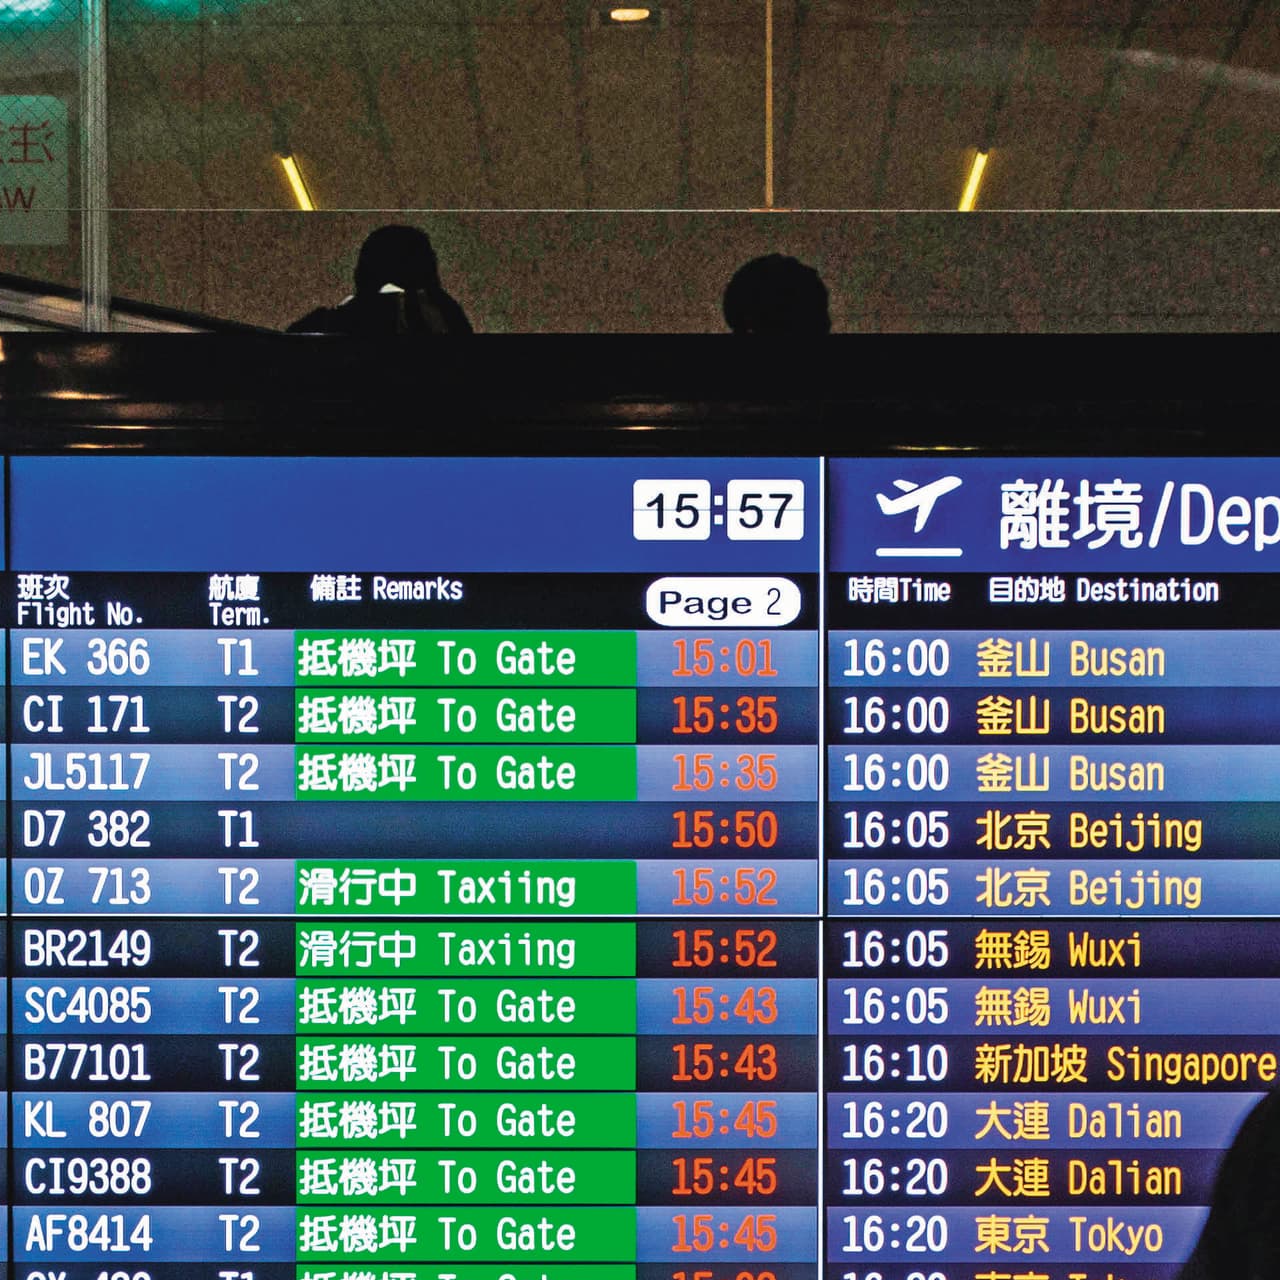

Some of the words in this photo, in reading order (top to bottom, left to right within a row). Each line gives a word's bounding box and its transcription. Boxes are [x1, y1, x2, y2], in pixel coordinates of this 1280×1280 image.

[646, 492, 793, 531] 15:57
[17, 573, 70, 601] 班次
[309, 574, 362, 602] 備註
[373, 575, 463, 600] Remarks
[660, 590, 752, 621] Page
[766, 587, 781, 616] 2
[848, 575, 951, 604] 時間Time
[989, 575, 1066, 603] 目的地
[1077, 577, 1219, 602] Destination
[17, 601, 96, 628] Flight
[107, 601, 143, 626] No.
[208, 601, 270, 626] Term.
[22, 637, 67, 675] EK
[86, 637, 151, 676] 366
[216, 637, 259, 676] T1
[298, 638, 417, 677] 抵機坪
[437, 640, 477, 675] To
[496, 640, 576, 675] Gate
[671, 637, 779, 677] 15:01
[843, 638, 950, 677] 16:00
[976, 637, 1050, 677] 釜山
[1070, 639, 1165, 677] Busan
[23, 694, 64, 733] CI
[87, 695, 150, 733] 171
[217, 695, 259, 733] T2
[298, 695, 417, 735] 抵機坪
[437, 698, 477, 733] To
[496, 698, 576, 733] Gate
[672, 696, 778, 734] 15:35
[23, 752, 151, 791] JL5117
[217, 752, 260, 791] T2
[23, 809, 66, 847] D7
[87, 809, 151, 848] 382
[217, 809, 259, 848] T1
[672, 810, 778, 848] 15:50
[24, 866, 65, 905] OZ
[87, 866, 151, 905] 713
[217, 866, 260, 905] T2
[299, 867, 416, 906] 滑行中
[437, 870, 576, 908] Taxiing
[671, 866, 778, 906] 15:52
[843, 867, 949, 906] 16:05
[975, 866, 1051, 908] 北京
[1069, 869, 1202, 909] Beijing
[975, 928, 1051, 970] 無錫
[1068, 931, 1141, 967] Wuxi
[24, 986, 152, 1024] SC4085
[843, 1044, 948, 1081] 16:10
[974, 1042, 1088, 1084] 新加坡
[1107, 1045, 1277, 1085] Singapore
[24, 1100, 67, 1138] KL
[88, 1100, 152, 1138] 807
[974, 1099, 1051, 1140] 大連
[1068, 1102, 1182, 1138] Dalian
